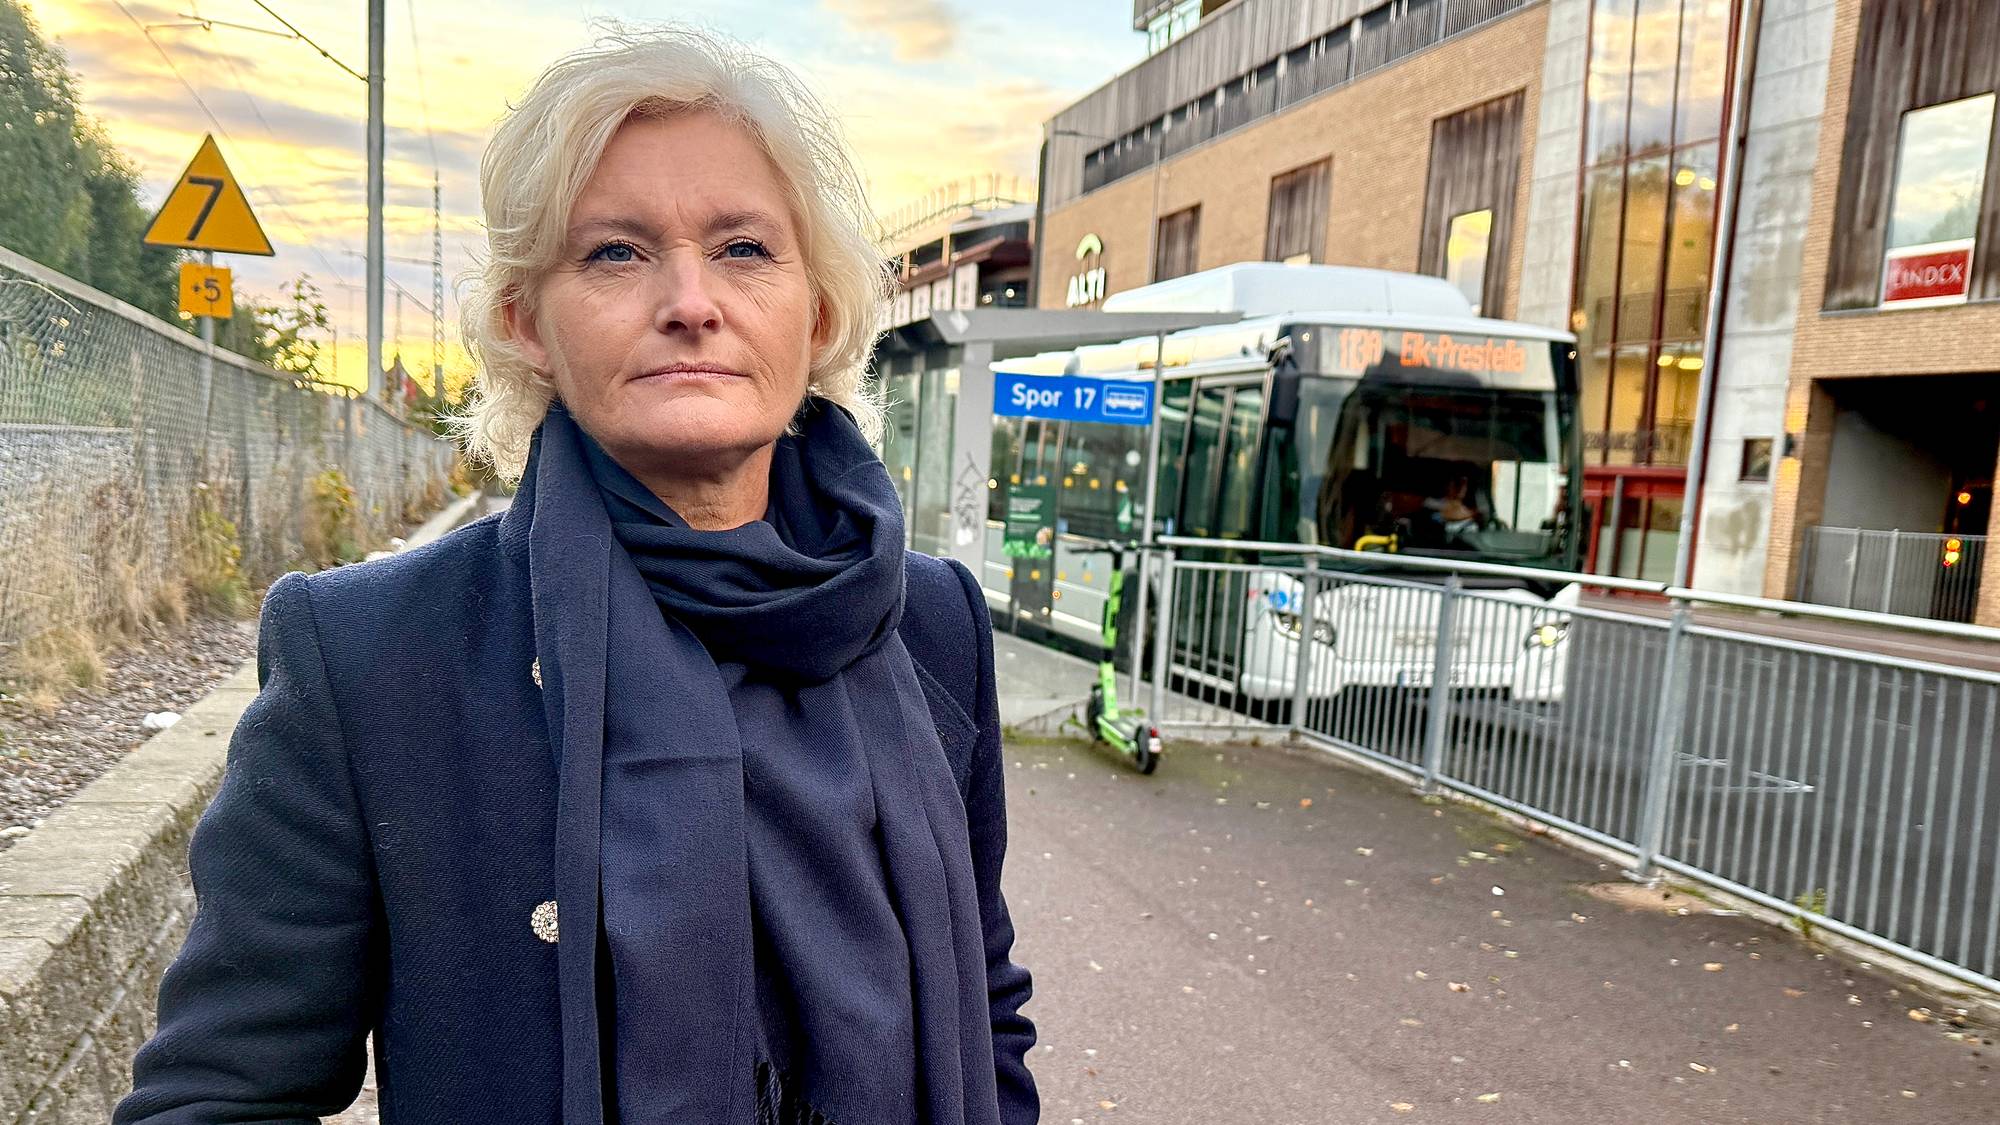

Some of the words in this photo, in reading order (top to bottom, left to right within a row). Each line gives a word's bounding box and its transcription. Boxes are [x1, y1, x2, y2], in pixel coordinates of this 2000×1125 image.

[187, 176, 224, 241] 7
[1066, 266, 1106, 307] ALTI
[1011, 382, 1063, 411] Spor
[1074, 386, 1097, 410] 17
